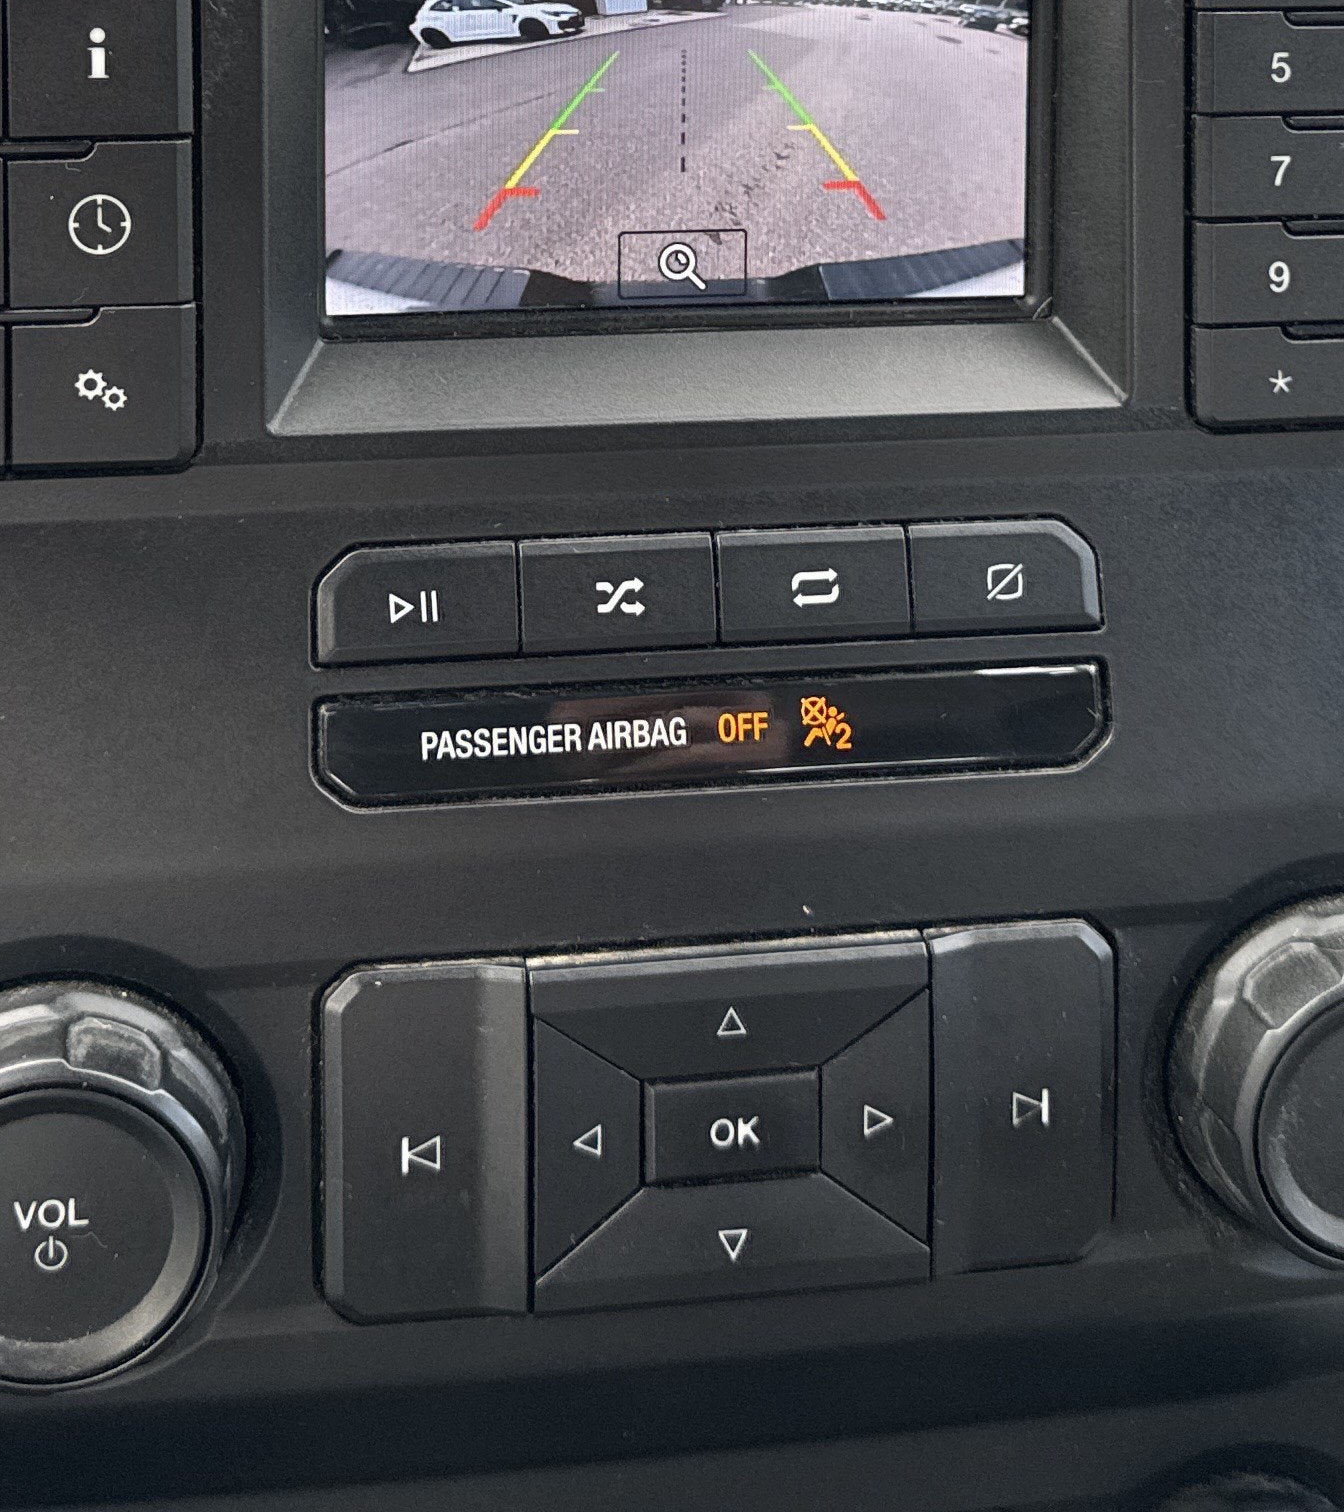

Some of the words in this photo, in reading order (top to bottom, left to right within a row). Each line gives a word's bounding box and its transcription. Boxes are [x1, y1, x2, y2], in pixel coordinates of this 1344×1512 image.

[1270, 51, 1292, 83] 5
[1270, 155, 1291, 187] 7
[1268, 260, 1290, 293] 9
[421, 723, 583, 761] PASSENGER
[587, 716, 687, 751] AIRBAG
[717, 711, 769, 743] OFF
[710, 1116, 760, 1147] OK
[13, 1197, 90, 1230] VOL
